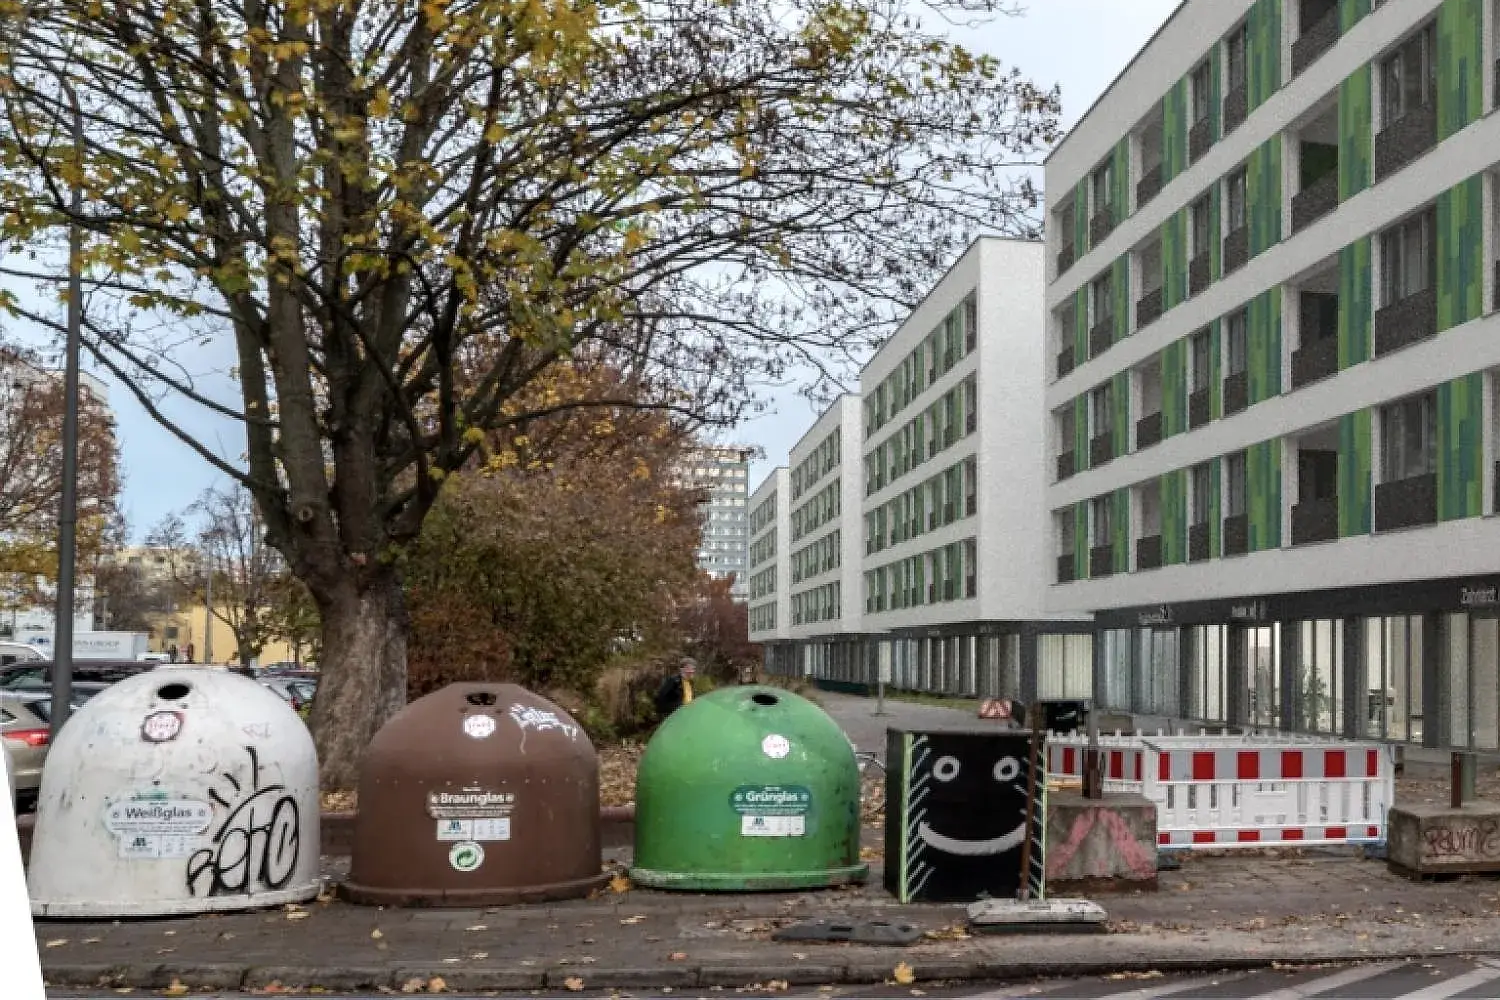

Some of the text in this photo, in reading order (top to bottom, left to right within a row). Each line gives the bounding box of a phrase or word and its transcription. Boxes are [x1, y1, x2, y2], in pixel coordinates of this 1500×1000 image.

[440, 792, 505, 806] Braunglas
[745, 790, 798, 805] Grünglas
[124, 806, 193, 820] Weißglas
